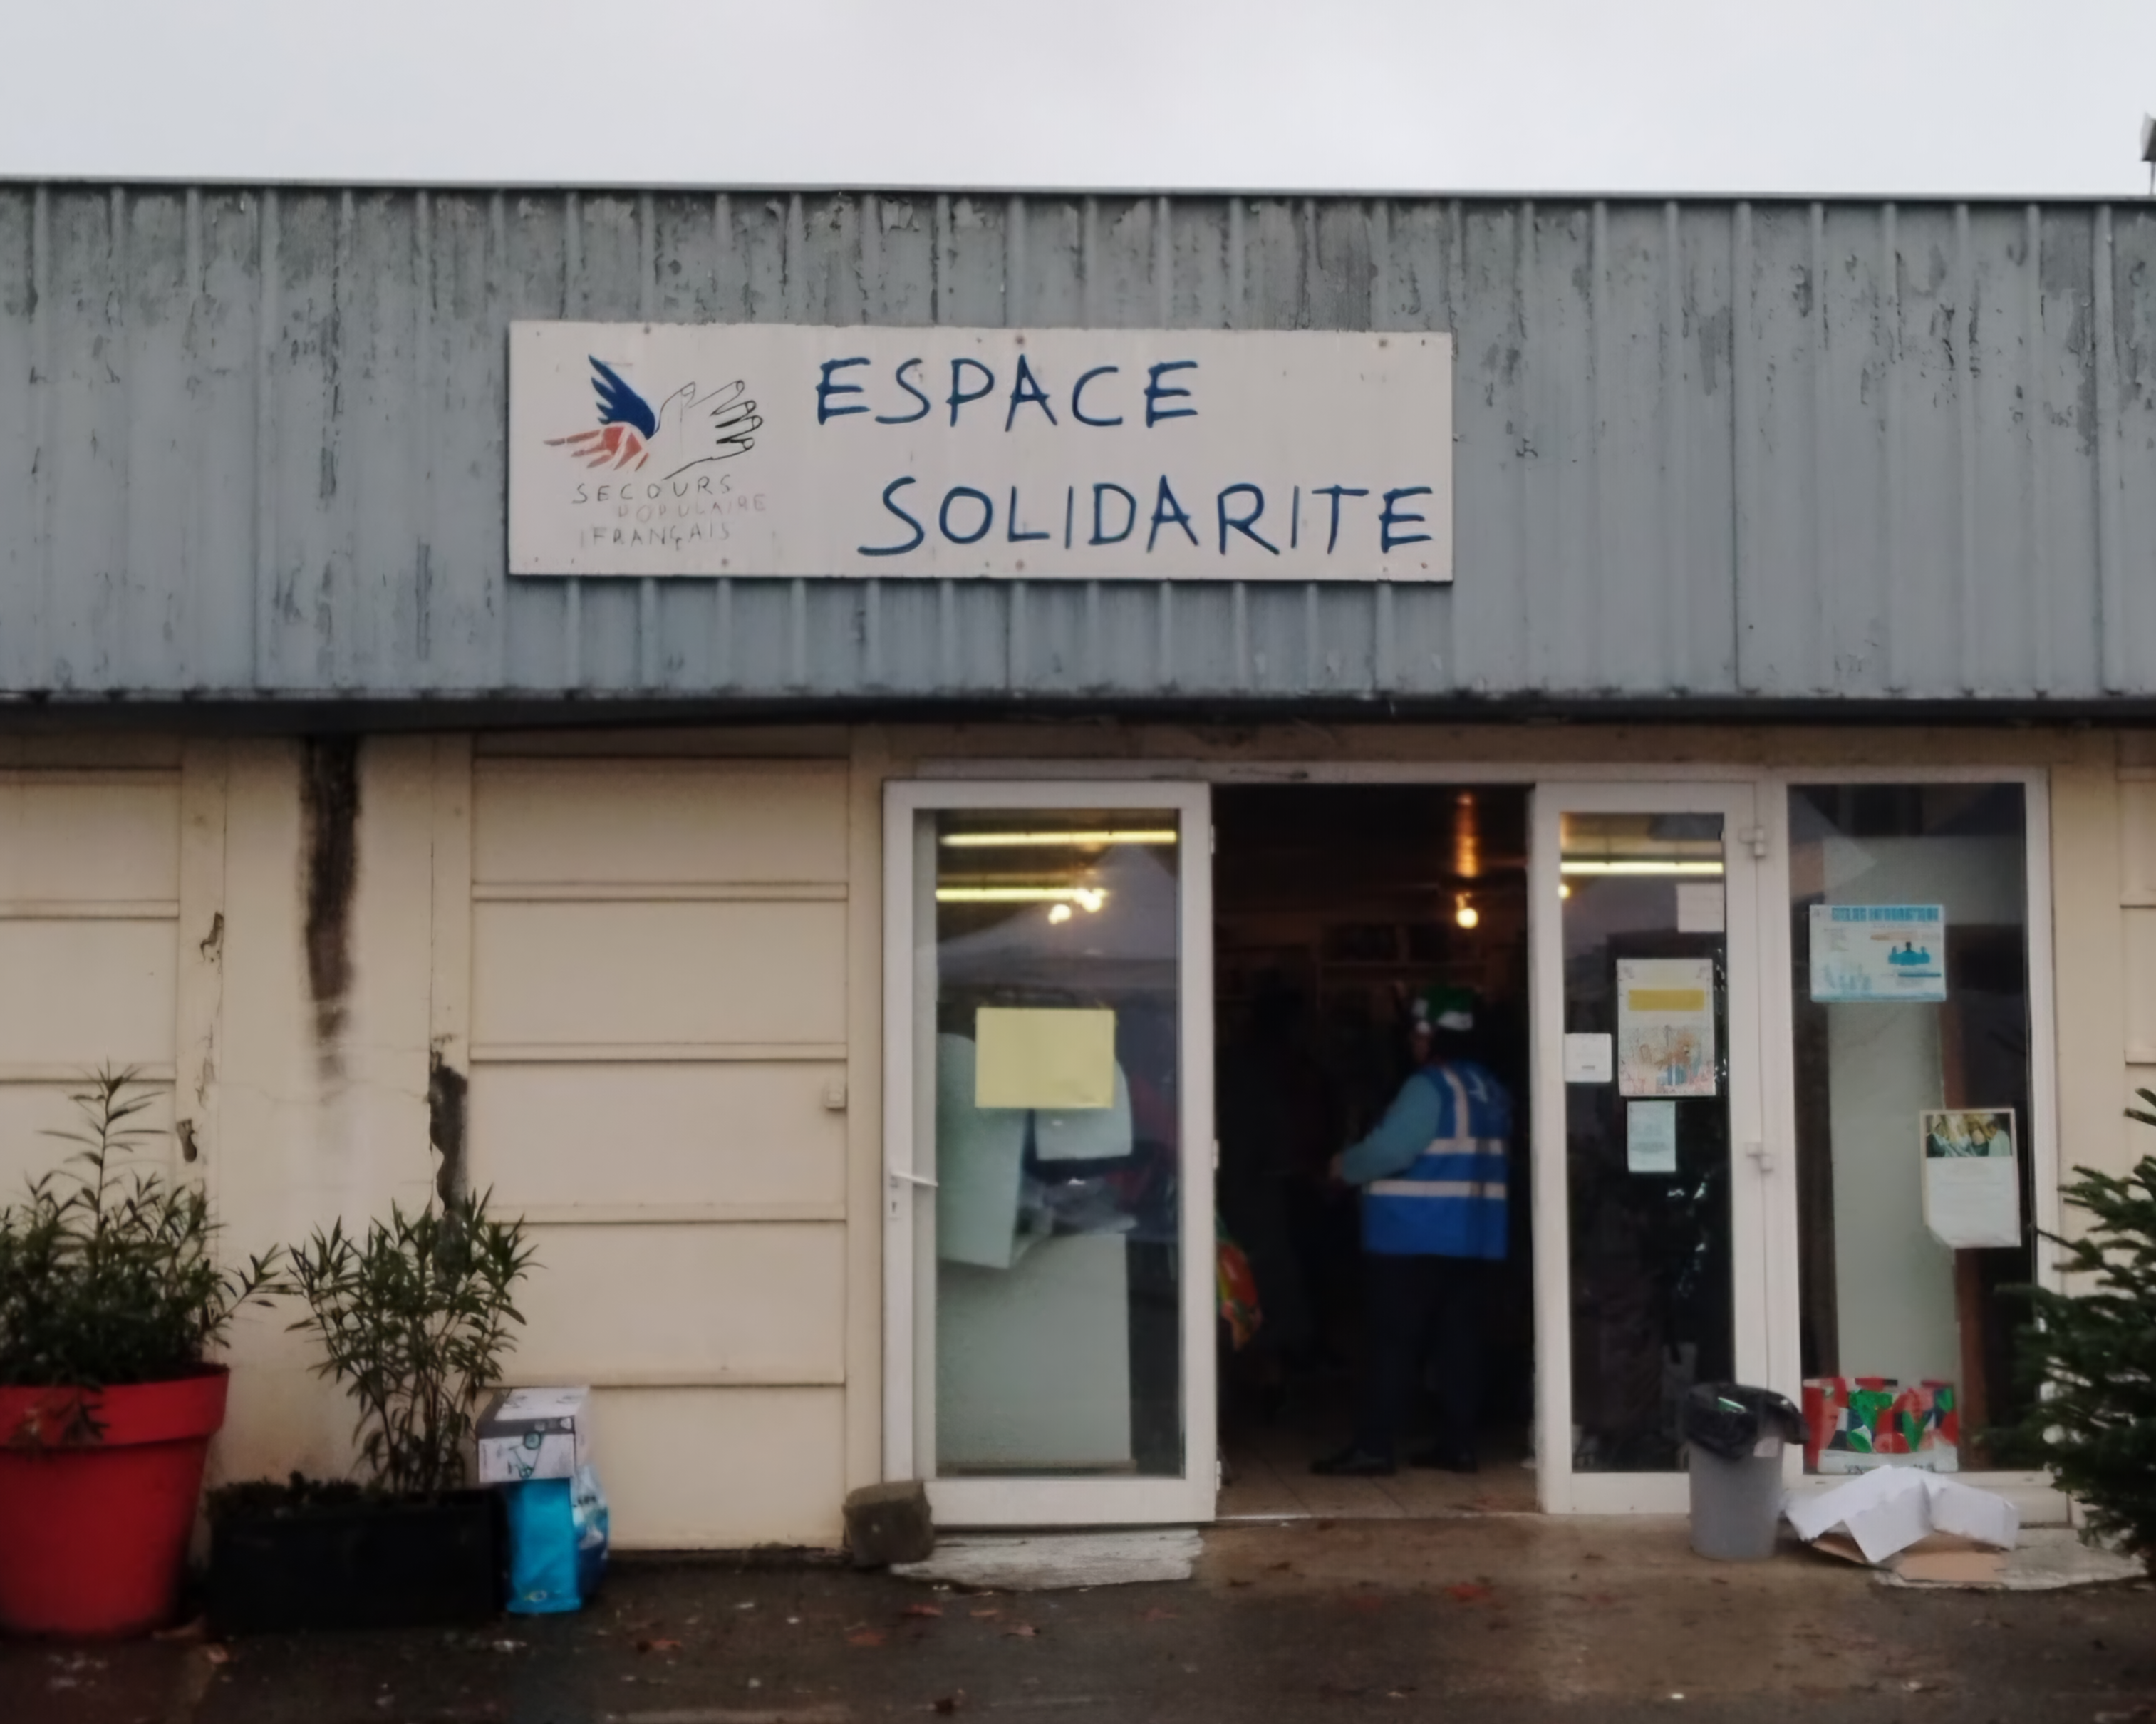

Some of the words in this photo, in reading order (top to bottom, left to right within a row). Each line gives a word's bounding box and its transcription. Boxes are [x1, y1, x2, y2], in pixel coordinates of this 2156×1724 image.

[816, 354, 1198, 432] ESPACE
[571, 474, 731, 504] SECOURS
[857, 475, 1433, 556] SOLIDARITE
[592, 522, 731, 551] FRANÇAIS
